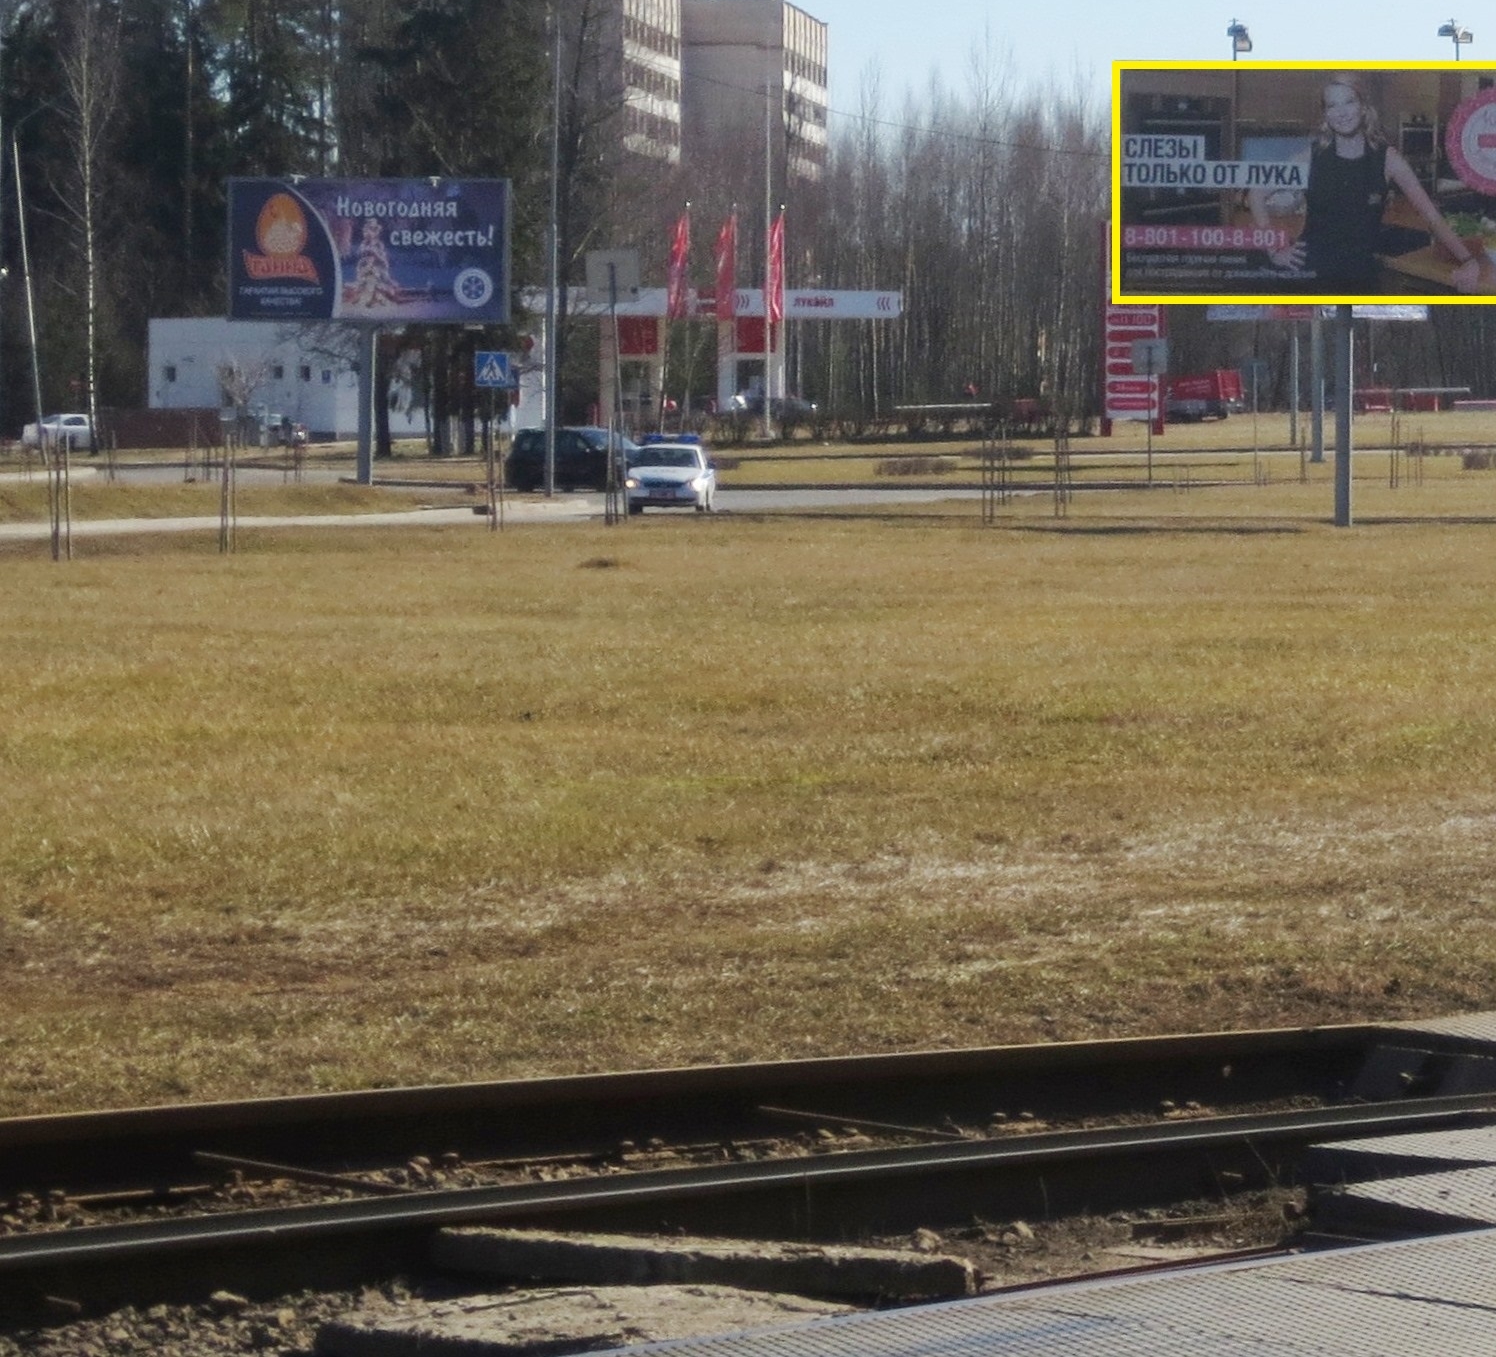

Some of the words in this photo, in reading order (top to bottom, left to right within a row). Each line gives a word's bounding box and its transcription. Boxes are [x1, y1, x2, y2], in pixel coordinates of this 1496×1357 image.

[1124, 136, 1198, 160] СЛЕЗЫ
[1124, 162, 1208, 185] ТОЛЬКО
[1211, 163, 1239, 185] ОТ
[1244, 164, 1302, 186] ЛУКА
[336, 195, 458, 218] Новогодняя
[390, 224, 495, 247] свежесть!
[1124, 227, 1286, 247] 8-801-100-8-801
